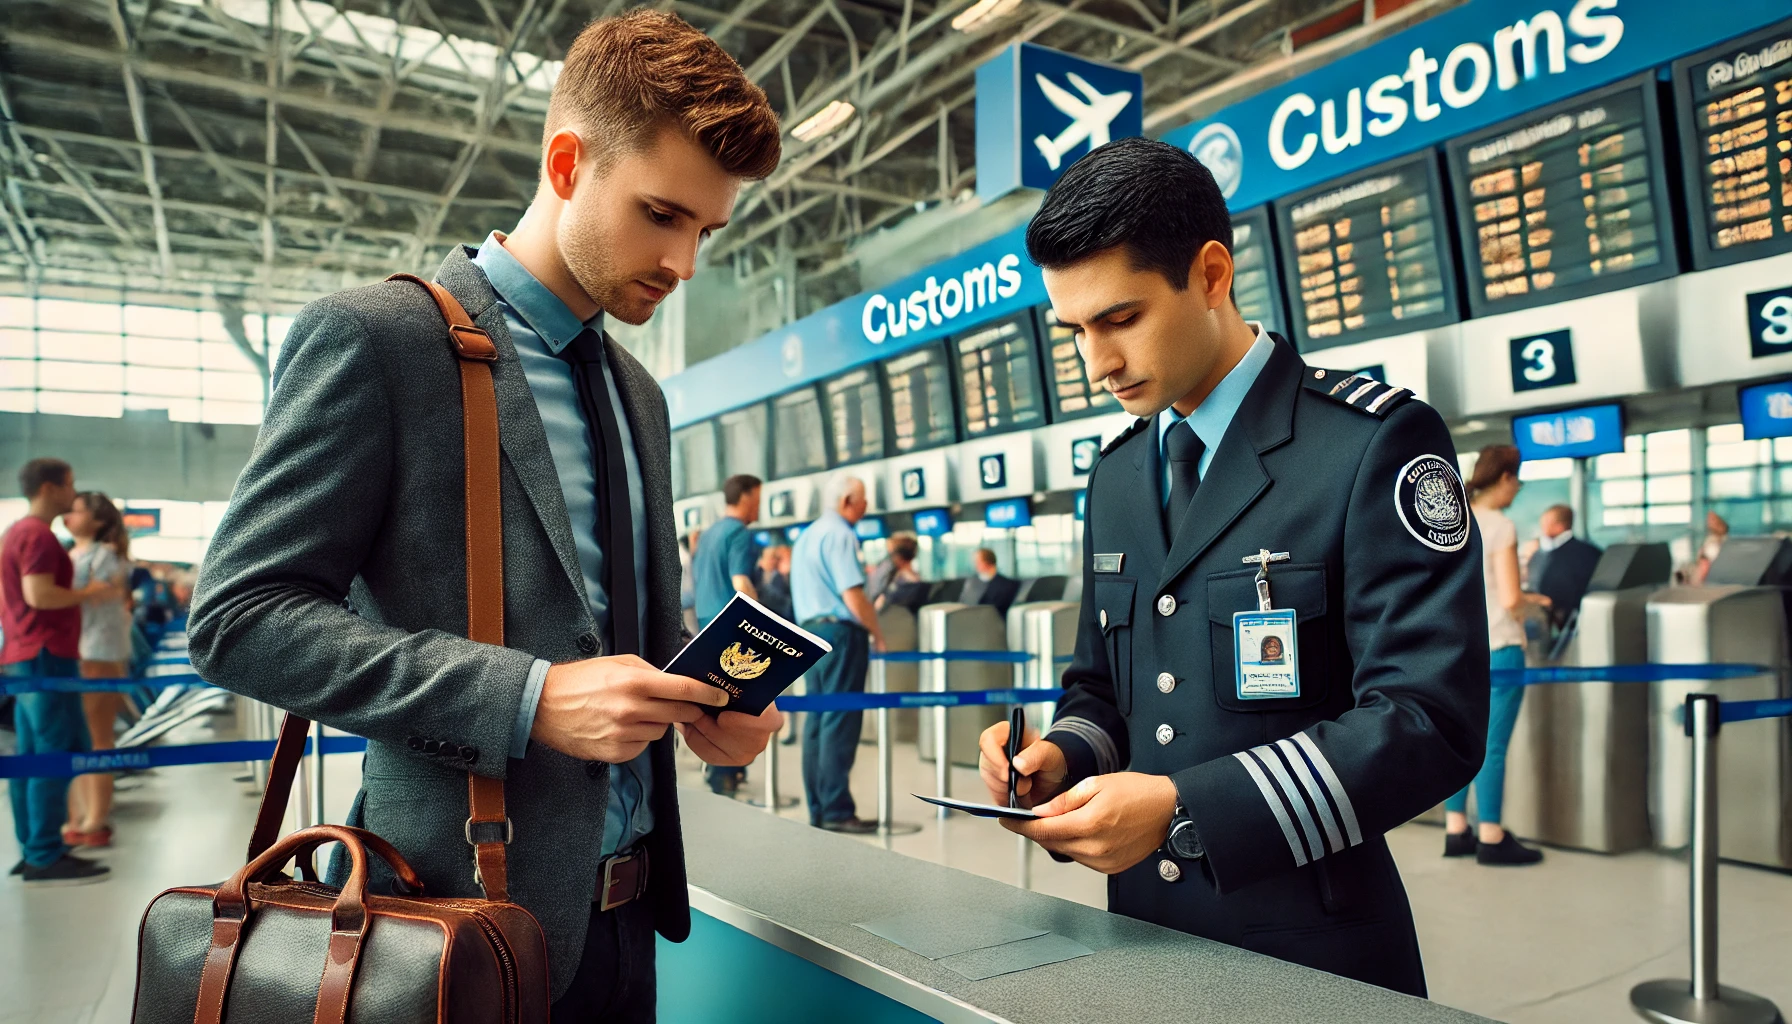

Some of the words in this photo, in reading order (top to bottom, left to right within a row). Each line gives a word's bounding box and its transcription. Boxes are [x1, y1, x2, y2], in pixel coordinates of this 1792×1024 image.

[1267, 0, 1625, 171] Customs
[861, 253, 1023, 345] Customs
[1521, 338, 1557, 383] 3
